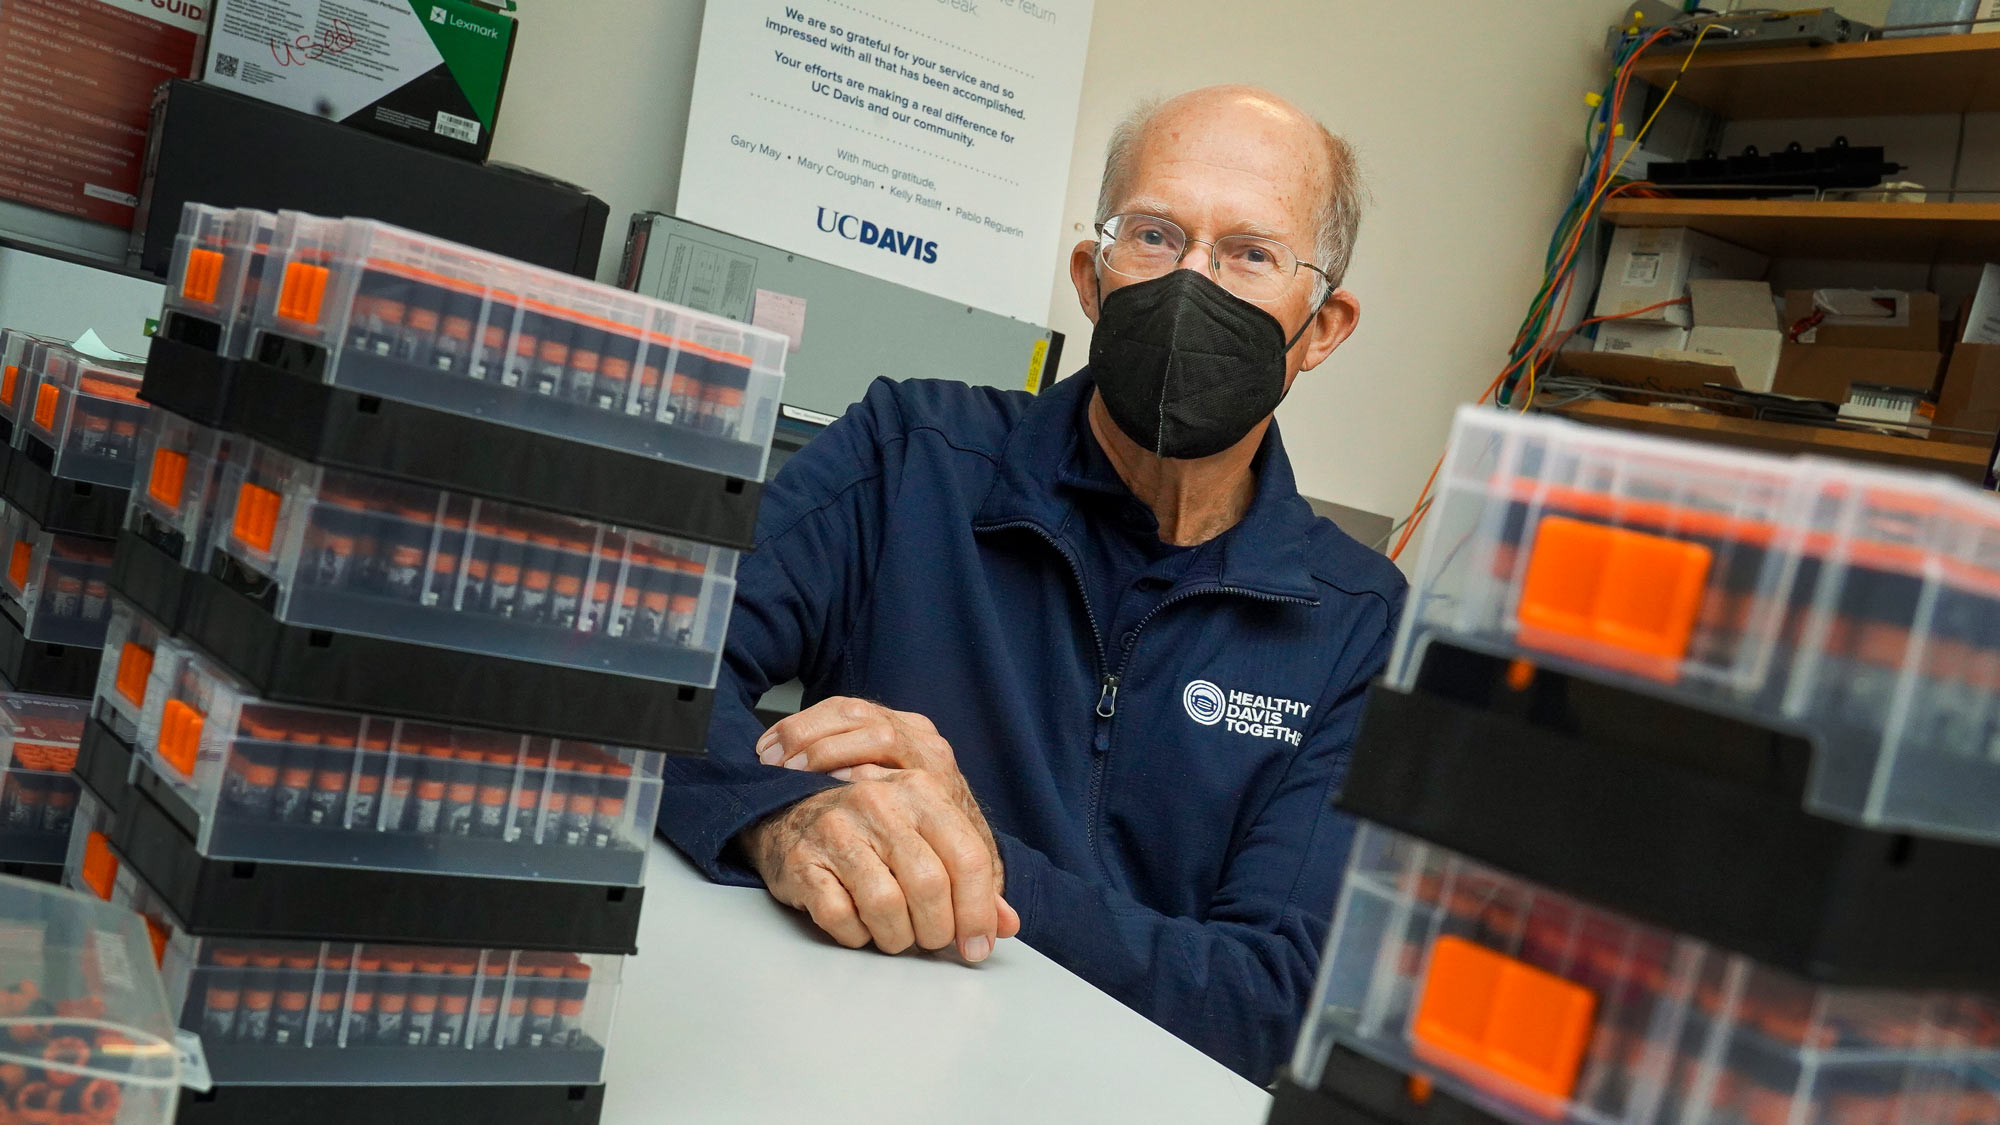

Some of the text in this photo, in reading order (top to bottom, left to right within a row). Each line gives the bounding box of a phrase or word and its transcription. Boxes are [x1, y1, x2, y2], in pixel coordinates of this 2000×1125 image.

[450, 14, 499, 39] Lexmark
[1018, 0, 1056, 24] return
[765, 17, 1026, 120] impressed with all that has been accomplished.
[786, 6, 1014, 99] We are so grateful for your service and so
[774, 50, 1015, 144] Your efforts are making a real difference for
[812, 81, 975, 147] UC Davis and our community.
[730, 134, 1024, 238] Gary May Mary Croughan Kelly Ratliff Pablo Reguerin
[837, 148, 937, 191] With much gratitude,
[1226, 704, 1282, 725] DAVIS
[1229, 689, 1311, 718] HEALTHY
